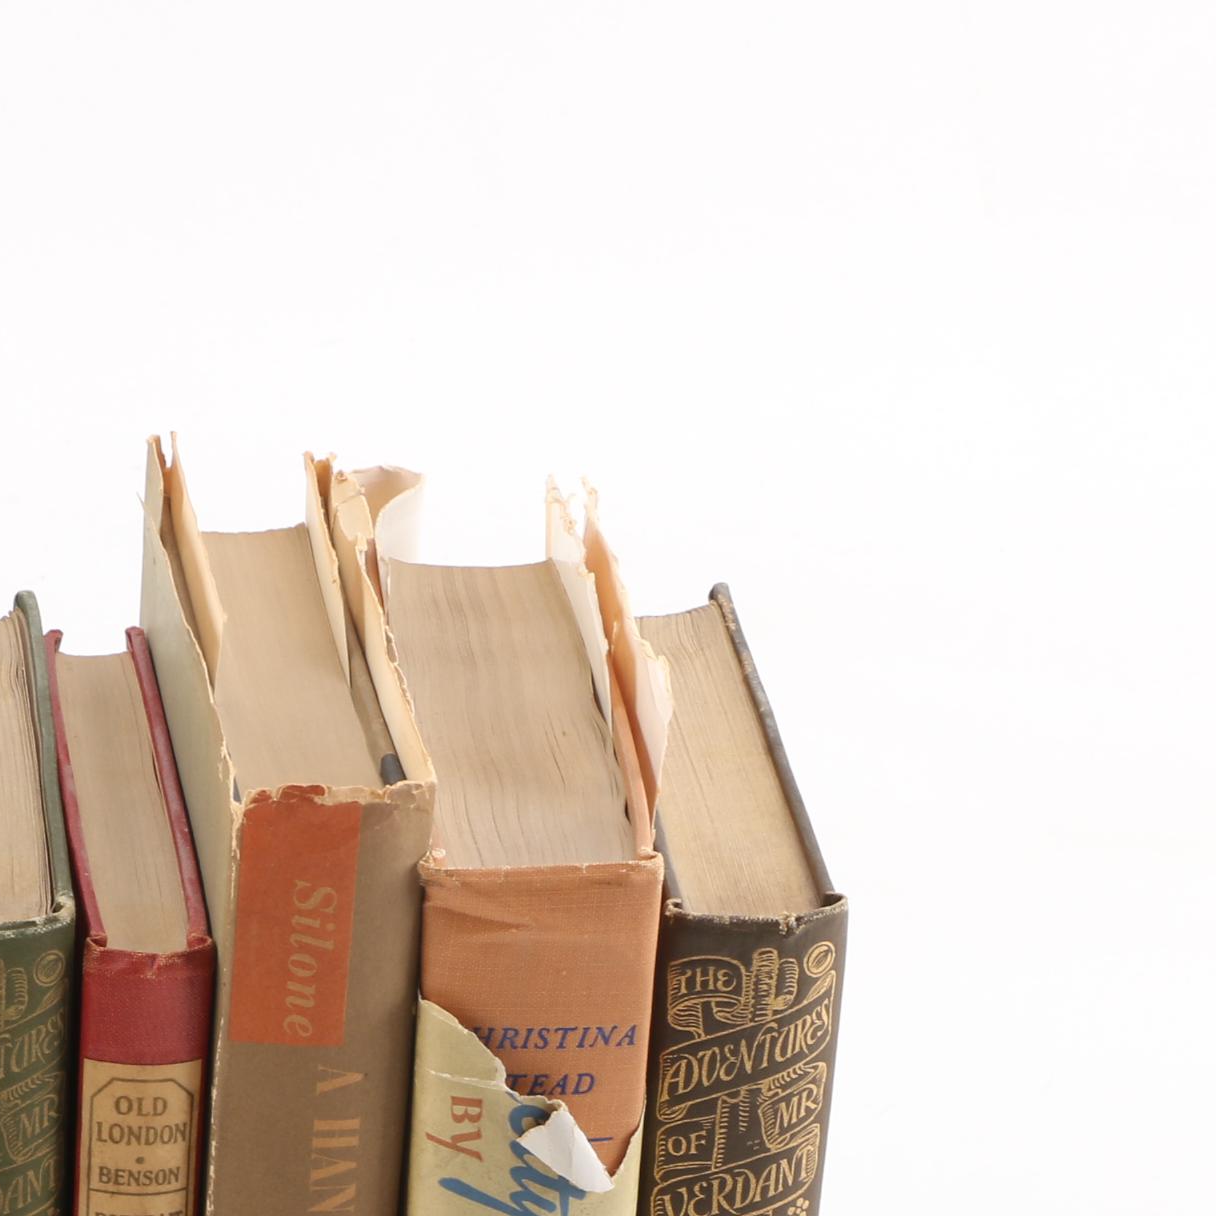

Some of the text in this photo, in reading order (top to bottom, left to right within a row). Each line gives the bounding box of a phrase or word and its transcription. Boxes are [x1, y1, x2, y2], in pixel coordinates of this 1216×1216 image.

[283, 879, 337, 1037] Silone
[678, 966, 736, 994] THE
[472, 1024, 637, 1050] HRISTINA
[662, 998, 829, 1101] ADVENTURES
[316, 1064, 367, 1096] A
[506, 1072, 596, 1096] TEAD
[114, 1095, 168, 1117] OLD
[96, 1121, 187, 1146] LONDON
[667, 1130, 706, 1156] OF
[98, 1166, 180, 1186] BENSON
